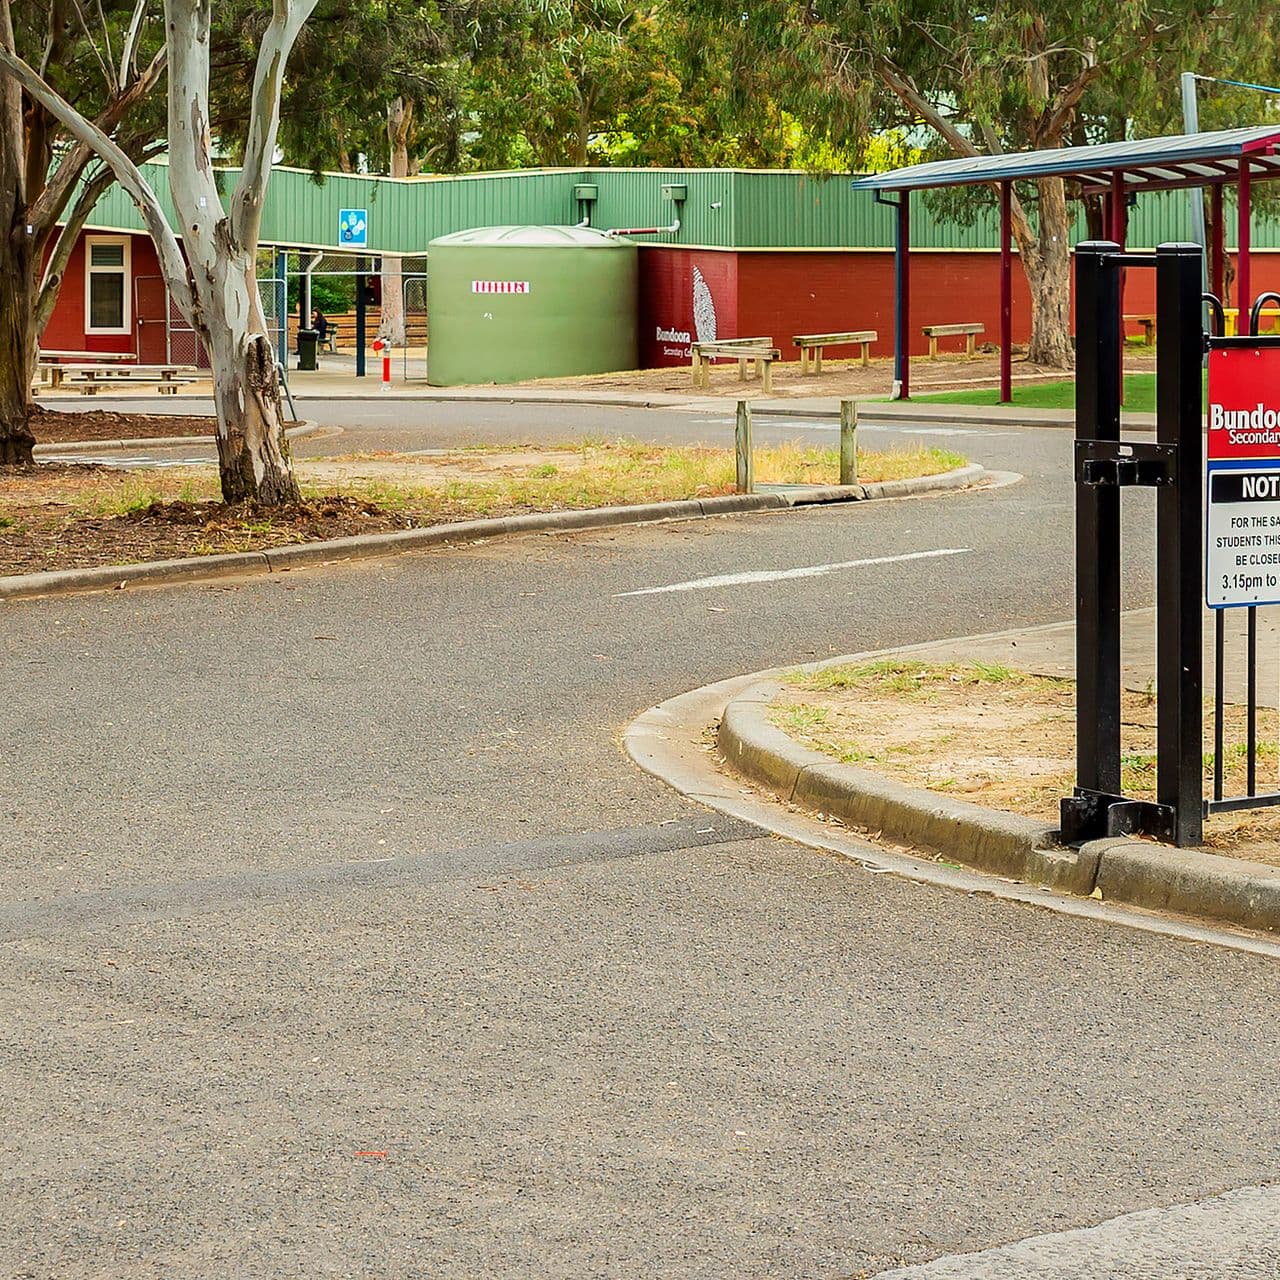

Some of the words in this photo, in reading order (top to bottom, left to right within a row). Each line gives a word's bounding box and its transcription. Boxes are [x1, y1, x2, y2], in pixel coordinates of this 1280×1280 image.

[1231, 516, 1249, 529] FOR
[1250, 516, 1268, 528] THE
[1216, 535, 1262, 548] STUDENTS
[1235, 554, 1248, 566] BE
[1222, 573, 1263, 592] 3.15pm
[1266, 574, 1276, 586] to
